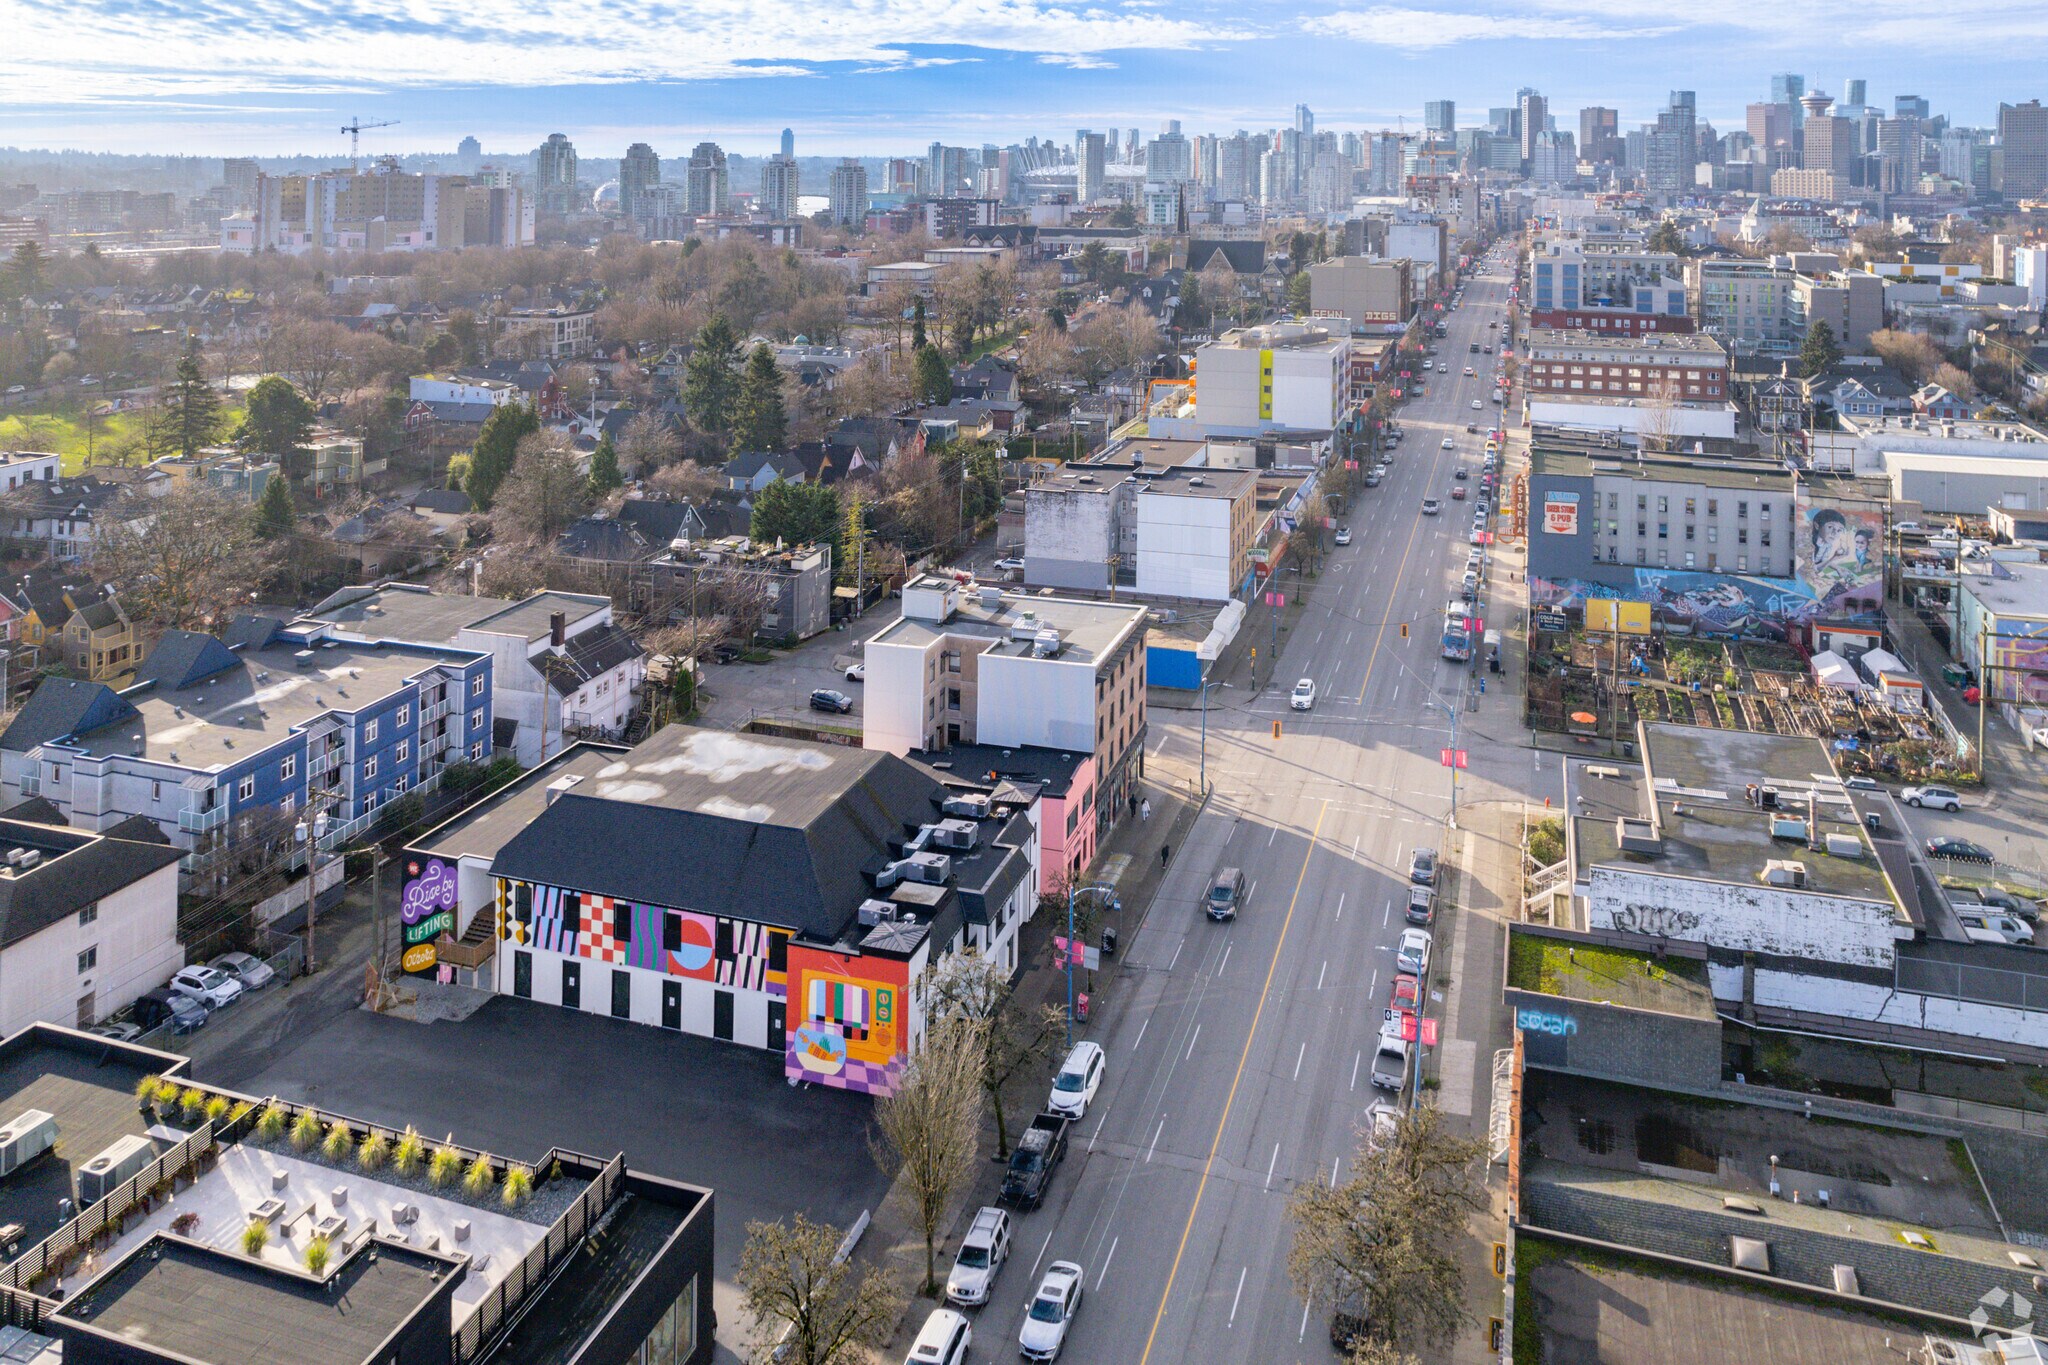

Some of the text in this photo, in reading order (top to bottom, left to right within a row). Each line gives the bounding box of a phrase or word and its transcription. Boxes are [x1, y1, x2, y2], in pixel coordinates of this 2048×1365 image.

[1366, 311, 1396, 321] DIGS
[1561, 506, 1576, 514] STORE
[1557, 514, 1571, 522] PUB
[404, 865, 455, 917] Rise by
[409, 914, 451, 941] LIFTING
